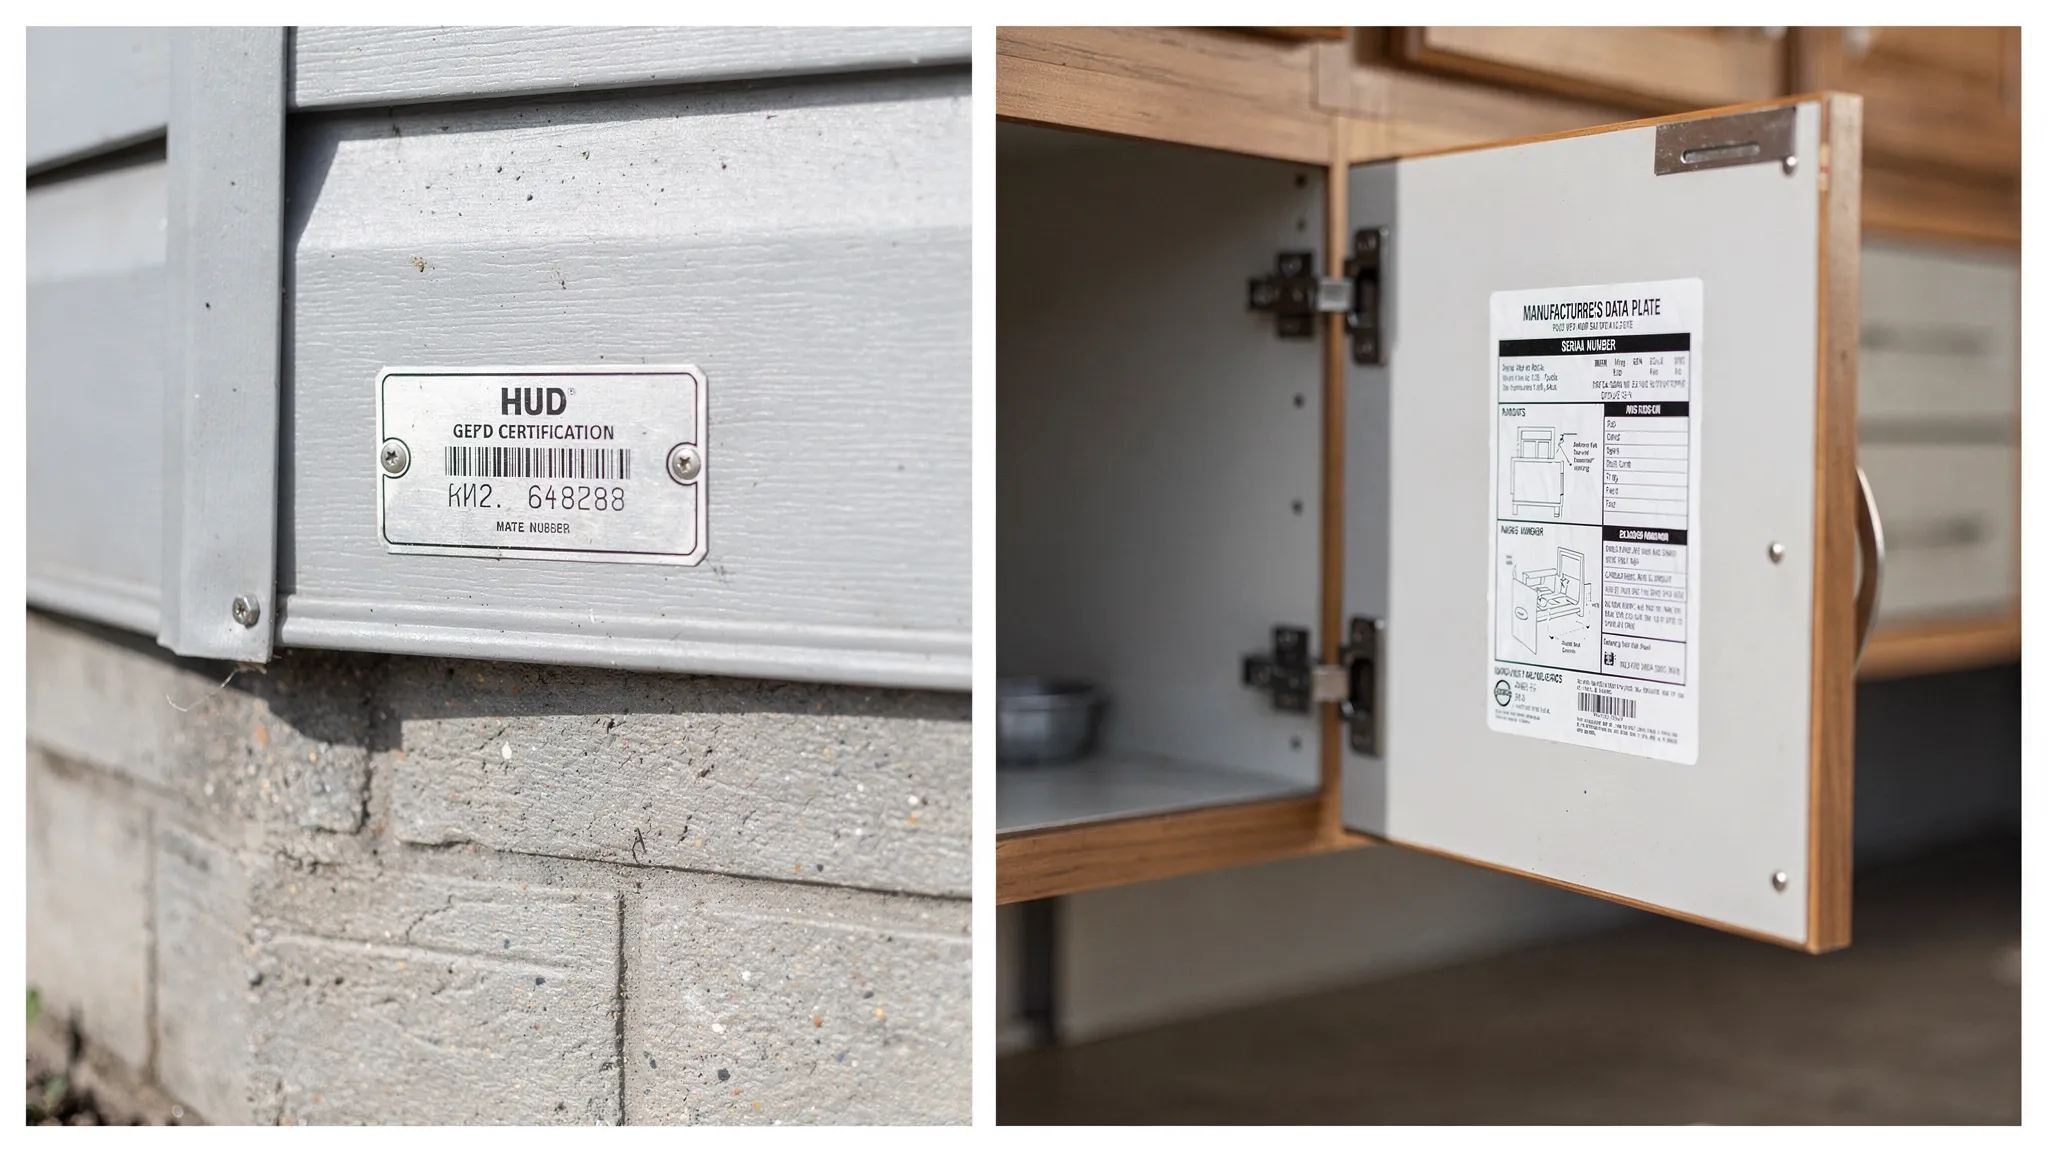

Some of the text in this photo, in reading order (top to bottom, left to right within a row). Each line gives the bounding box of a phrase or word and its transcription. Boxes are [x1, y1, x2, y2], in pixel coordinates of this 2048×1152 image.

[1605, 300, 1629, 317] DATA
[1632, 298, 1661, 316] PLATE
[502, 387, 567, 415] HUD
[498, 424, 614, 440] CERTIFICATION
[528, 485, 625, 511] 648288
[496, 521, 525, 532] MATE
